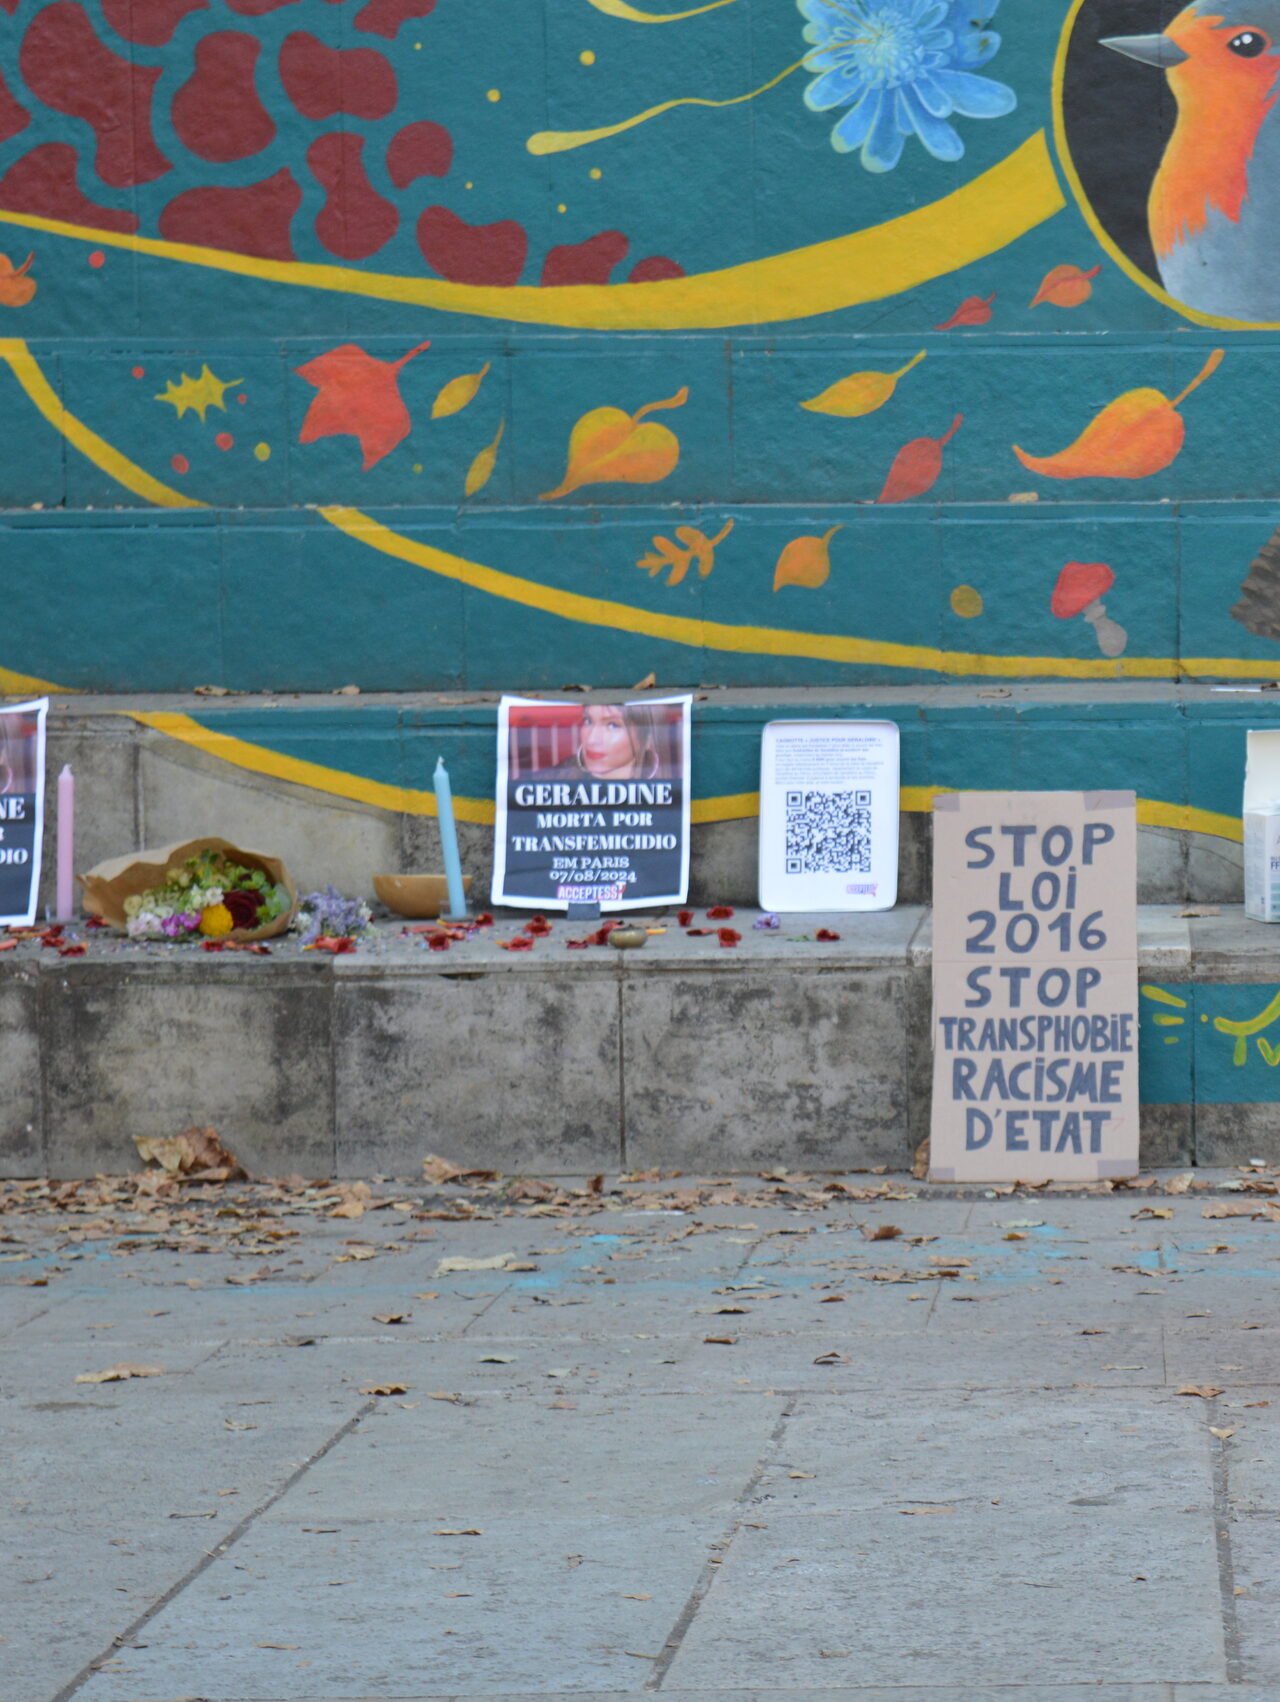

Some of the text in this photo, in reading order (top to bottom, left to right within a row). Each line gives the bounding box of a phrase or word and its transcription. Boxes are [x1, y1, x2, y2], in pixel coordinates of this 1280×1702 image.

[514, 782, 673, 806] GERALDINE
[536, 811, 653, 829] MORTA POR
[512, 833, 677, 852] TRANSFEMICIDIO
[965, 823, 1115, 869] STOP
[552, 856, 630, 869] EM PARIS
[550, 870, 637, 883] 07/08/2024
[965, 910, 1107, 954] 2016
[964, 965, 1102, 1008] STOP
[965, 1107, 1112, 1155] D'ETAT
